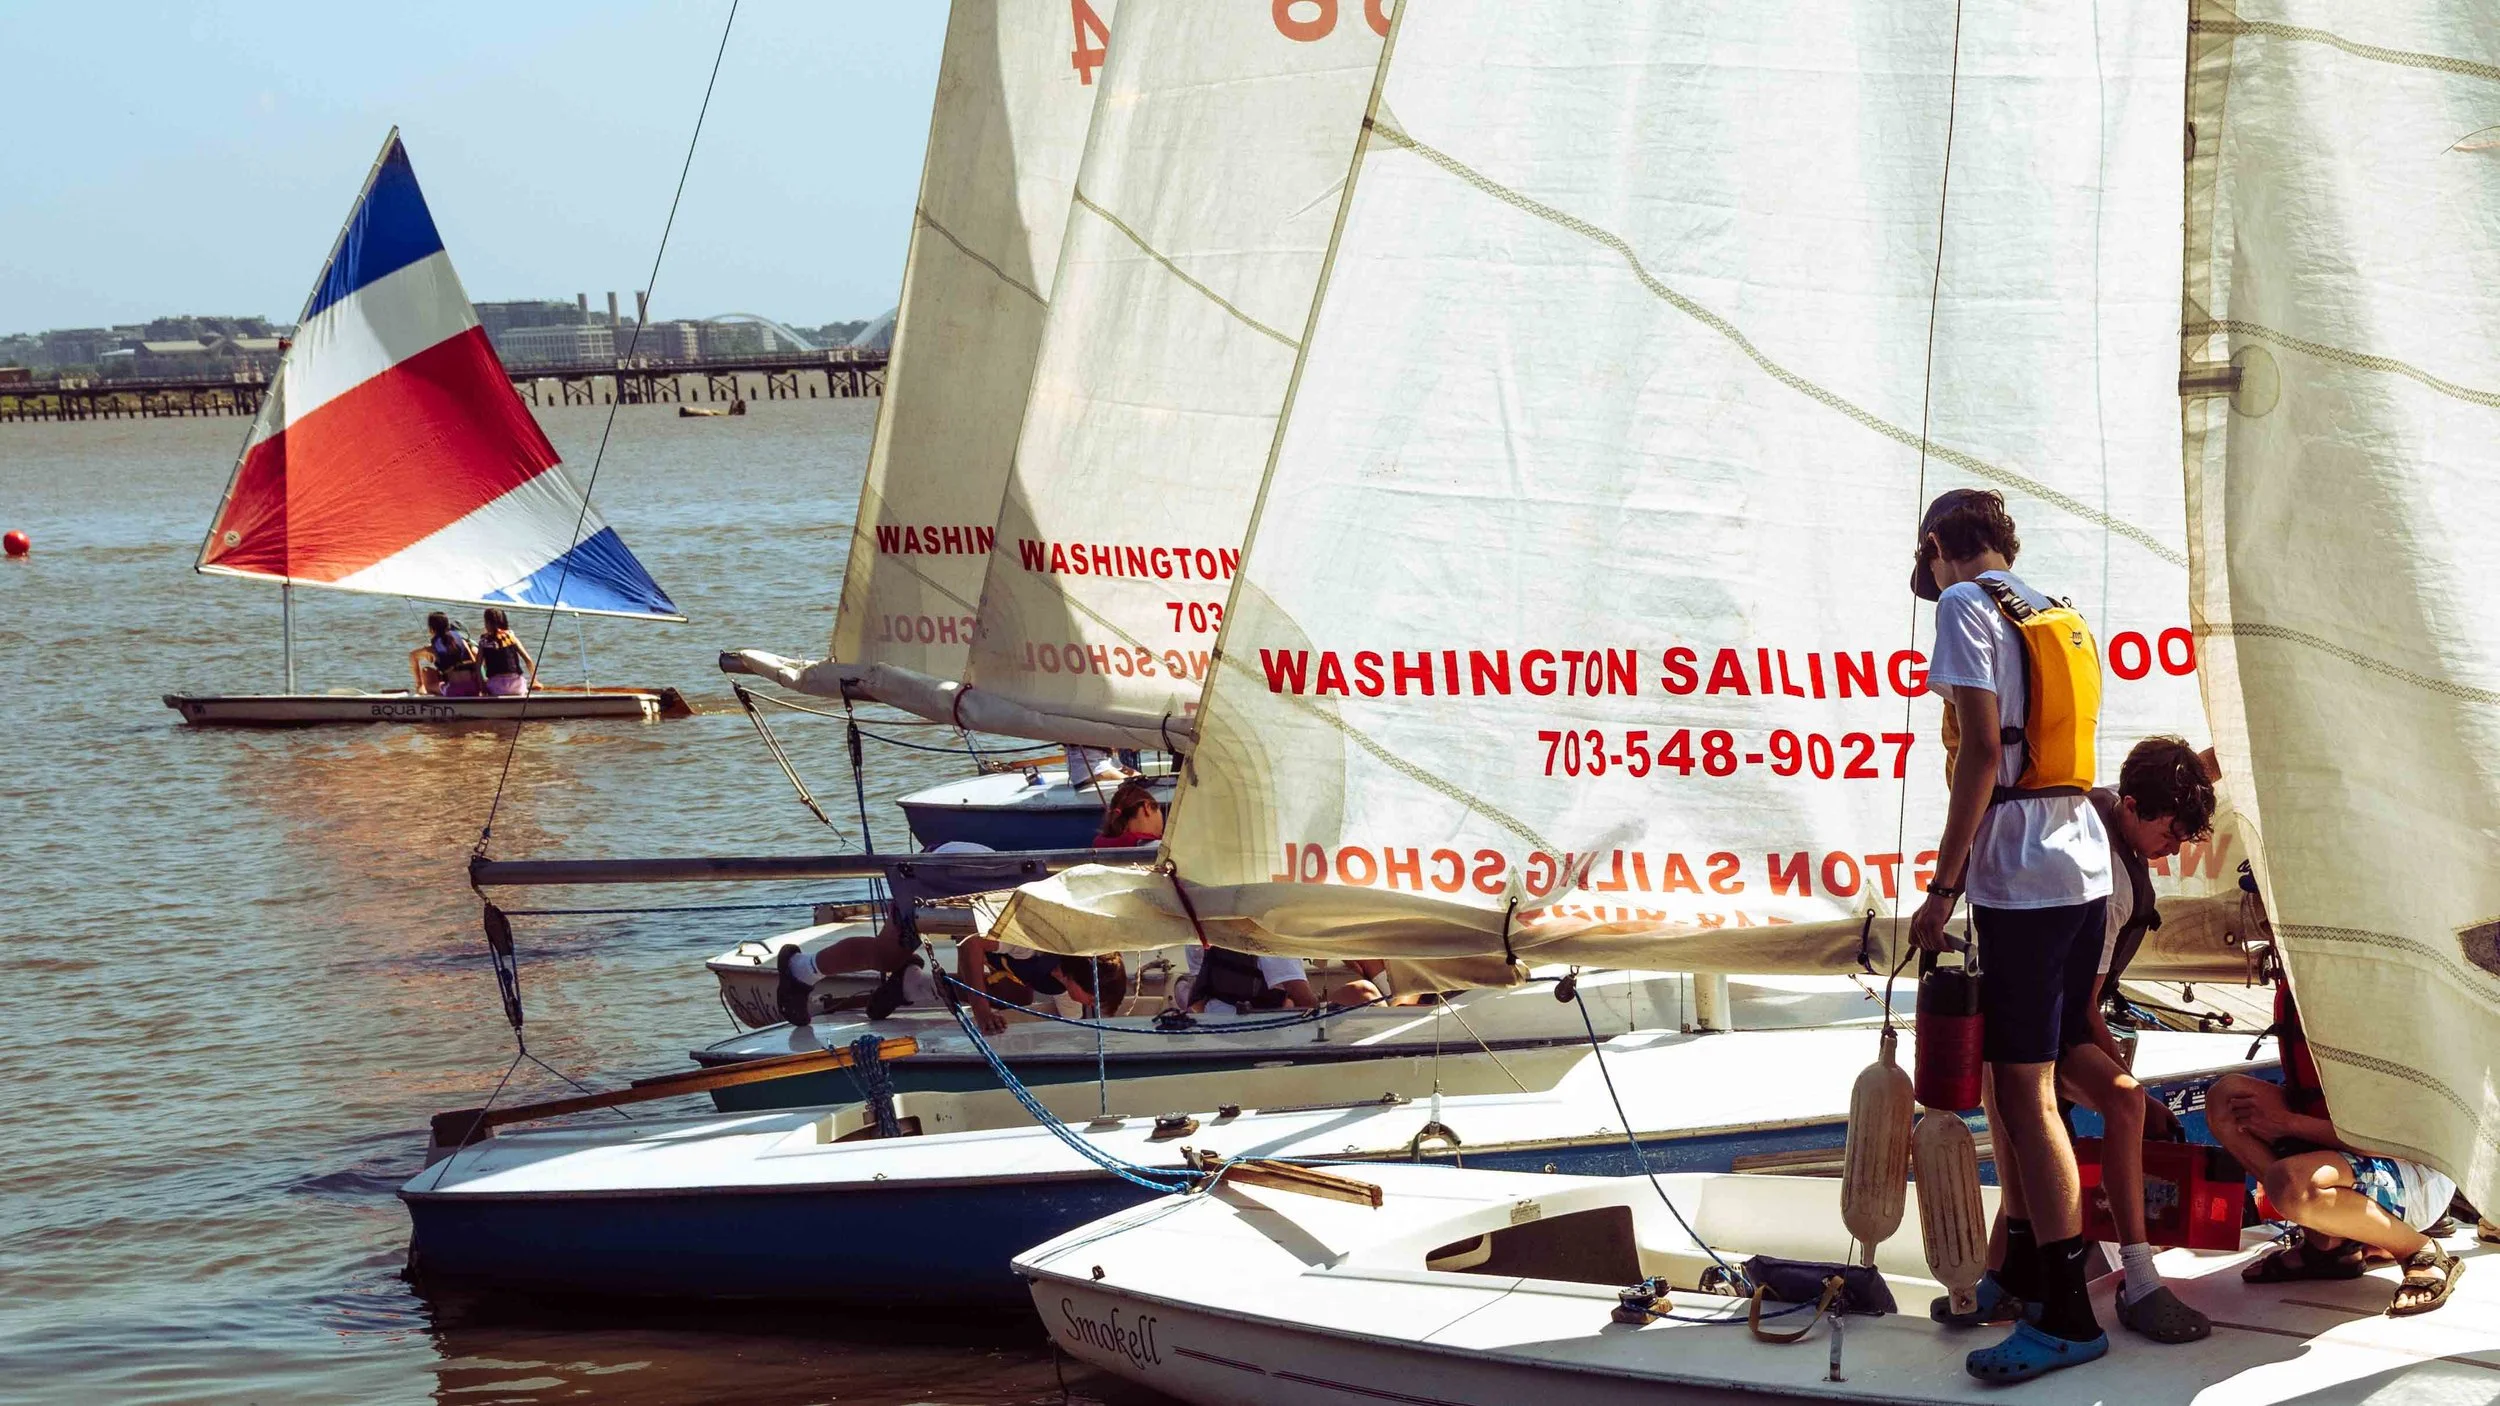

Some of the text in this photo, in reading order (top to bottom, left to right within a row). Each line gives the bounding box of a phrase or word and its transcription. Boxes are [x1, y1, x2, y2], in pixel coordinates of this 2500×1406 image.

[876, 525, 994, 554] WASHIN
[1018, 538, 1240, 580] WASHINGTON
[1166, 602, 1223, 633] 703
[1259, 648, 1638, 697] WASHINGTON
[1661, 646, 1930, 699] SAILING
[1538, 728, 1915, 781] 703-548-9027
[1061, 1297, 1162, 1370] Smokell
